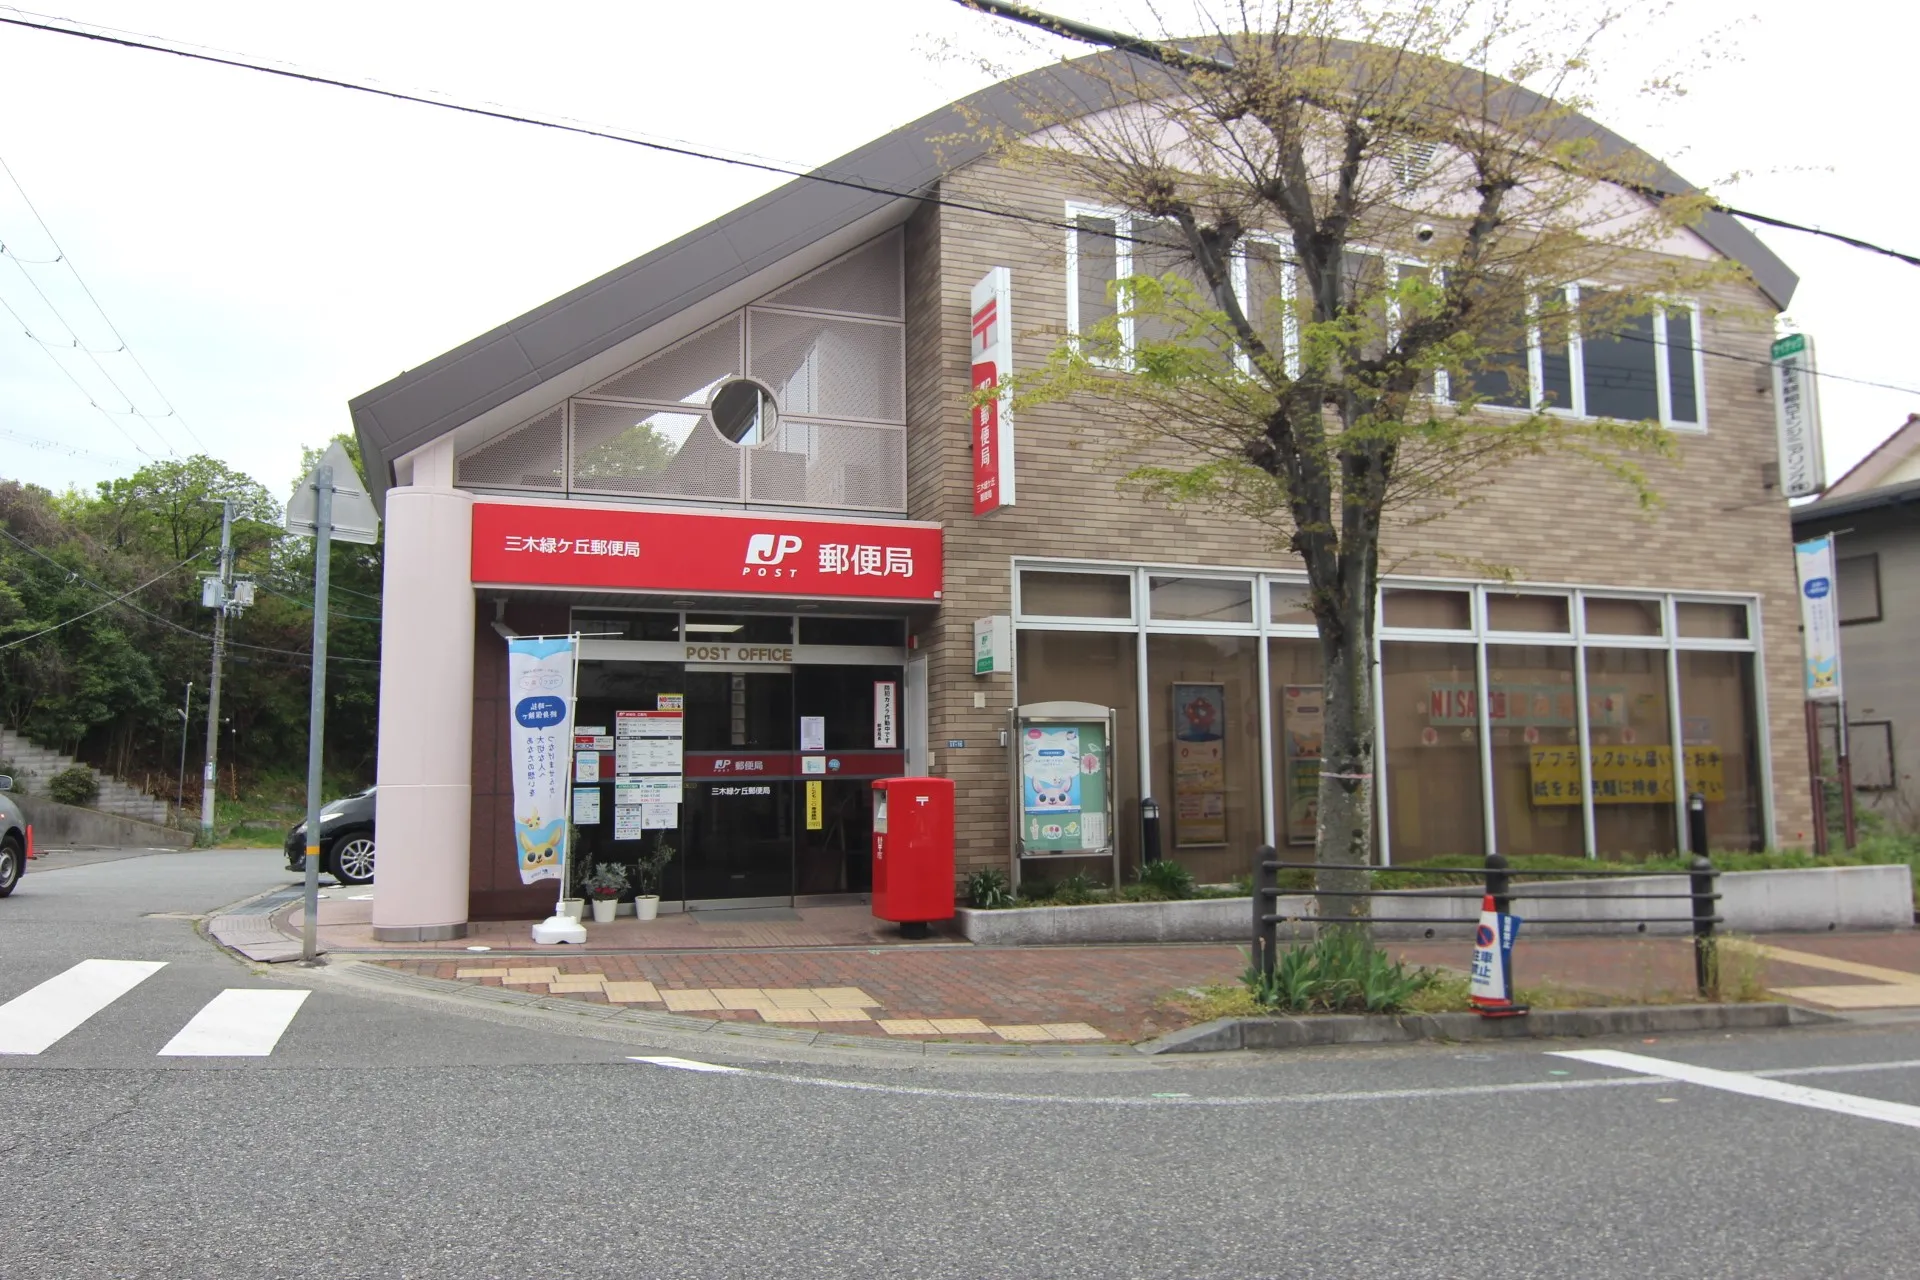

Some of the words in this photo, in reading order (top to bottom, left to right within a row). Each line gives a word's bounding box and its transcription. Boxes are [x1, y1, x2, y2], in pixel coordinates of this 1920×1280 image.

[504, 535, 641, 558] 三木緑ケ丘郵便局
[744, 533, 803, 565] JP
[818, 543, 914, 578] 郵便局
[742, 567, 798, 578] POST
[686, 647, 730, 661] POST
[737, 647, 793, 662] OFFICE
[735, 761, 763, 771] 郵便局
[711, 786, 771, 796] 三木緑ケ丘郵便局
